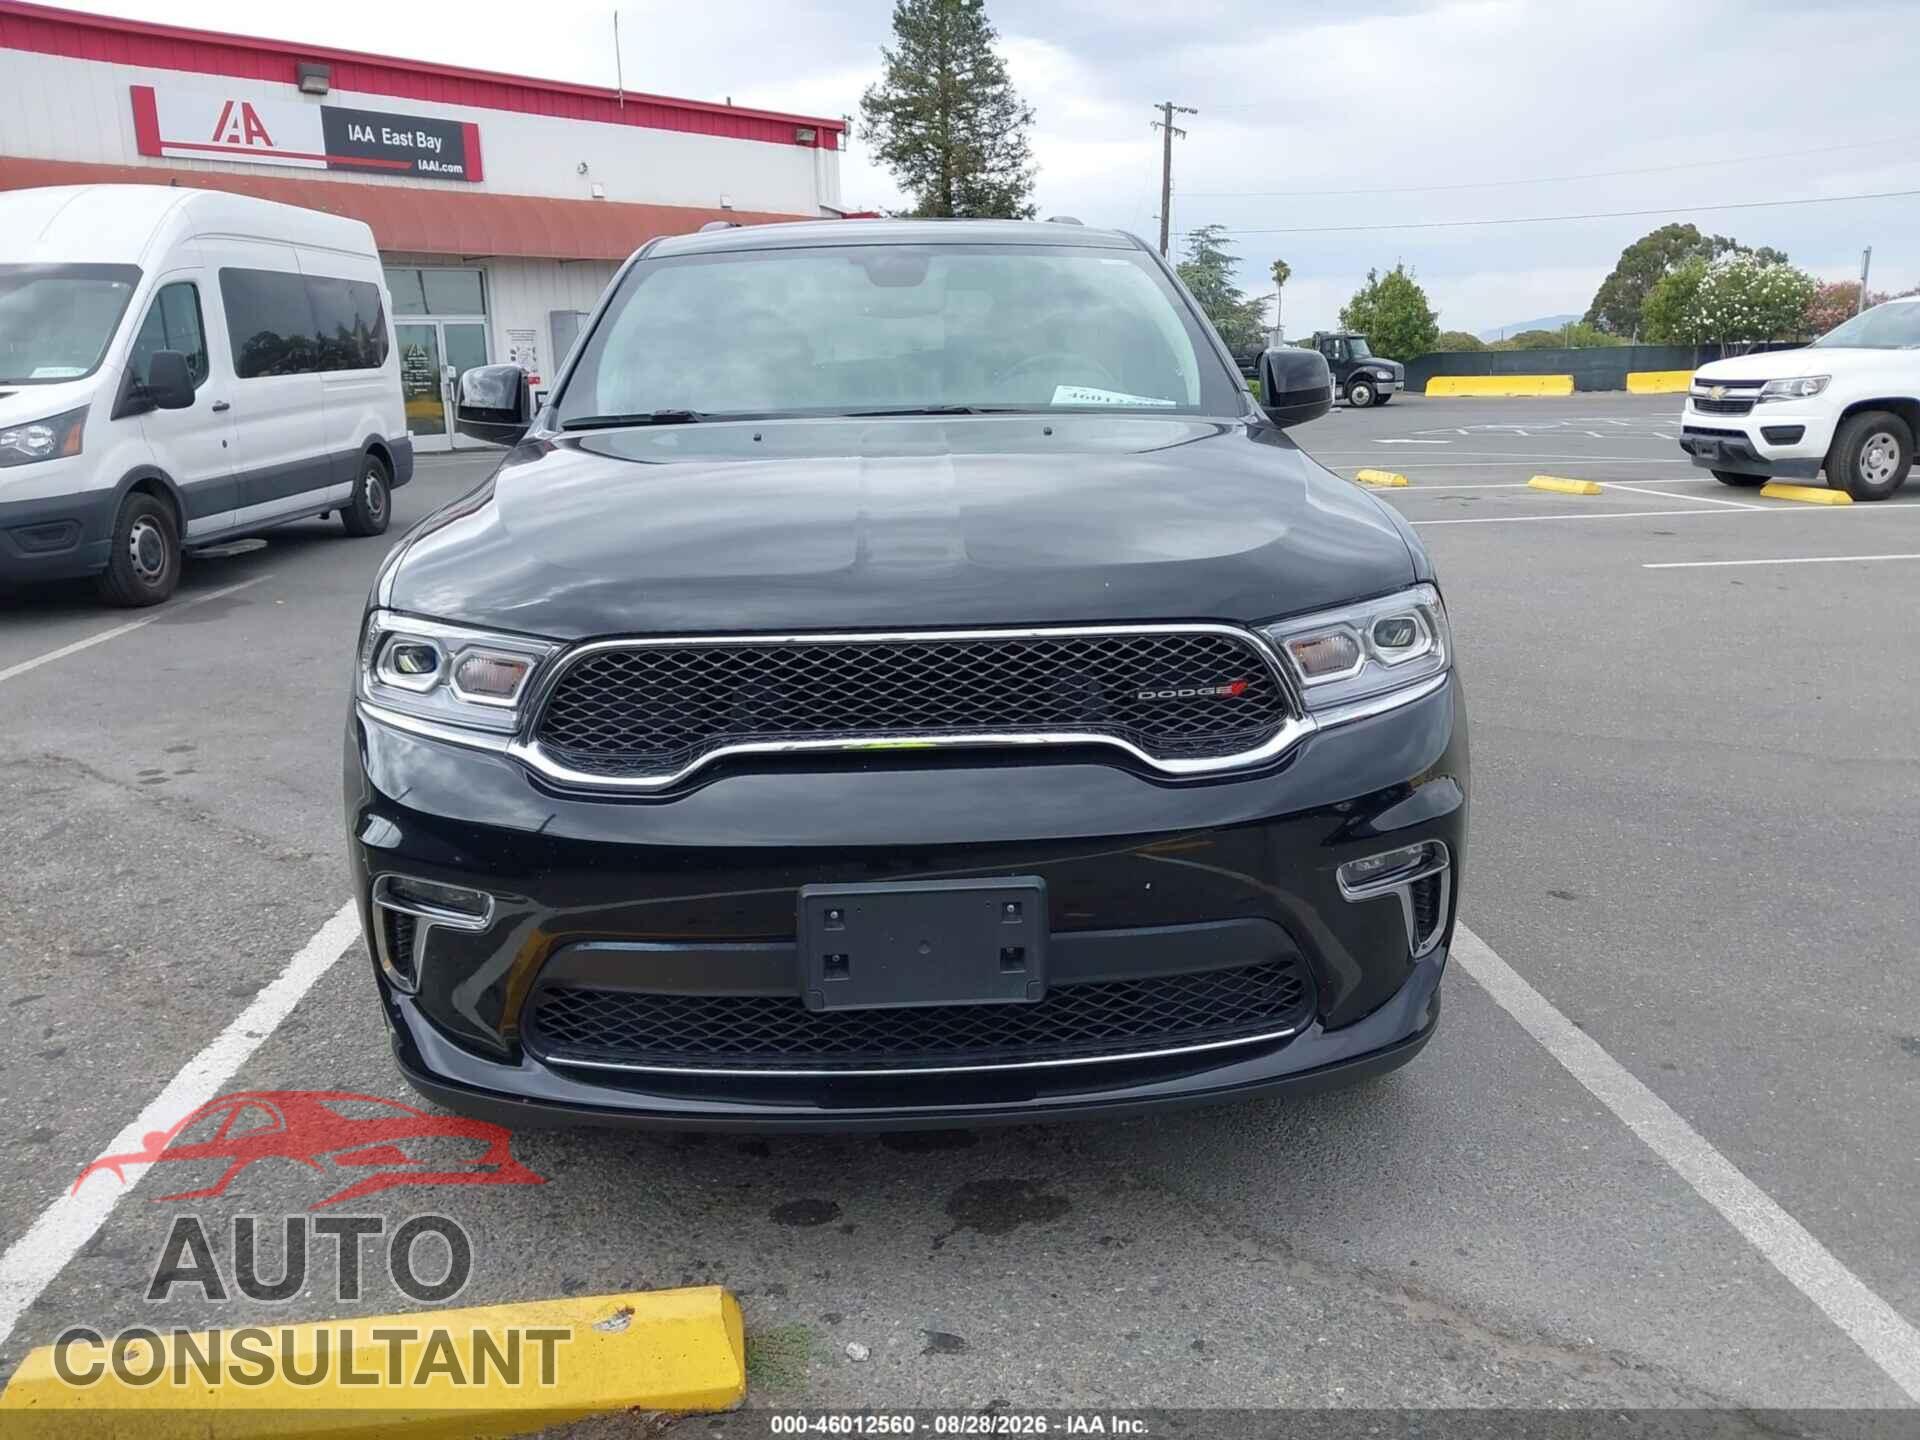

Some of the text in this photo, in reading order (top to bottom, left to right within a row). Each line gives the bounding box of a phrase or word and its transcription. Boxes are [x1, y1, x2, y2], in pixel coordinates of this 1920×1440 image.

[348, 124, 442, 153] IAA East Bay
[418, 159, 464, 175] IAAI.com
[1138, 686, 1233, 700] DODGE
